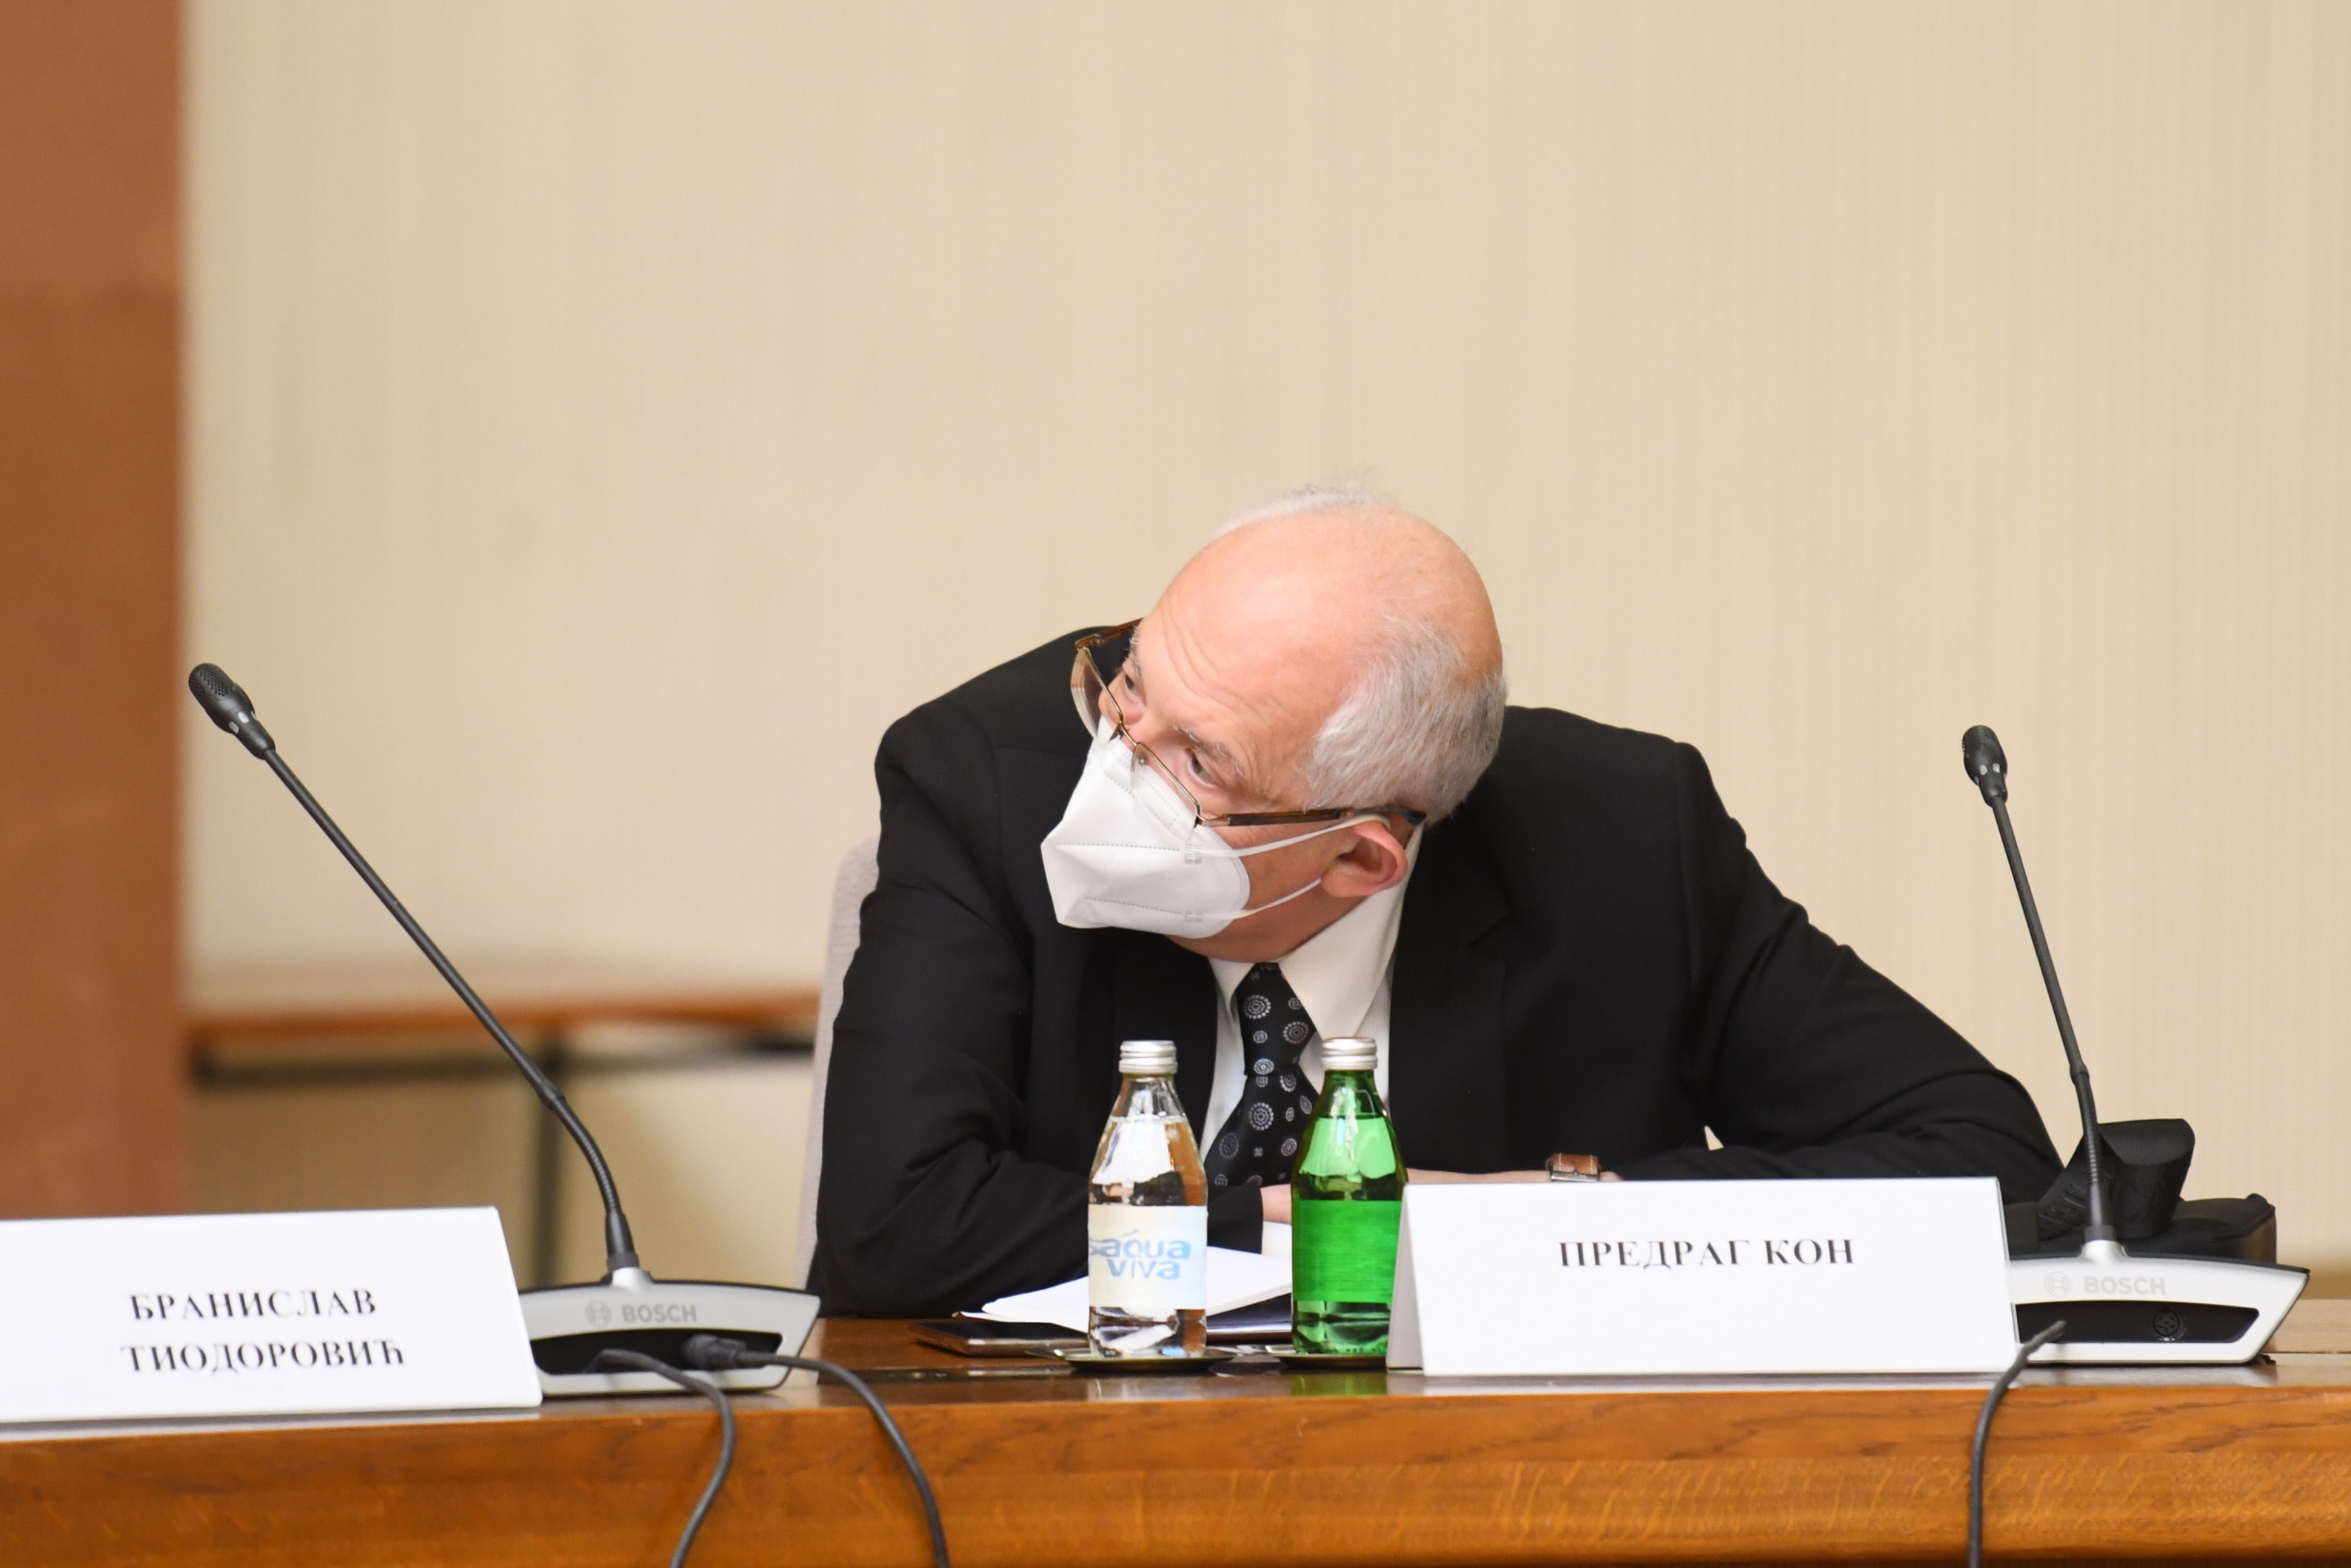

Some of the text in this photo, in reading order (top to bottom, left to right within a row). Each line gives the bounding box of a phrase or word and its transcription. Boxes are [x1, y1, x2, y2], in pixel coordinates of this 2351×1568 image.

[1559, 1239, 1854, 1270] ПРЕДРАГ КОН
[1106, 1259, 1181, 1279] viva
[2084, 1276, 2167, 1296] BOSCH
[130, 1289, 376, 1321] БРАНИСЛАВ
[622, 1304, 698, 1323] BOSCH
[121, 1339, 406, 1376] ТИОДОРОВИЋ
